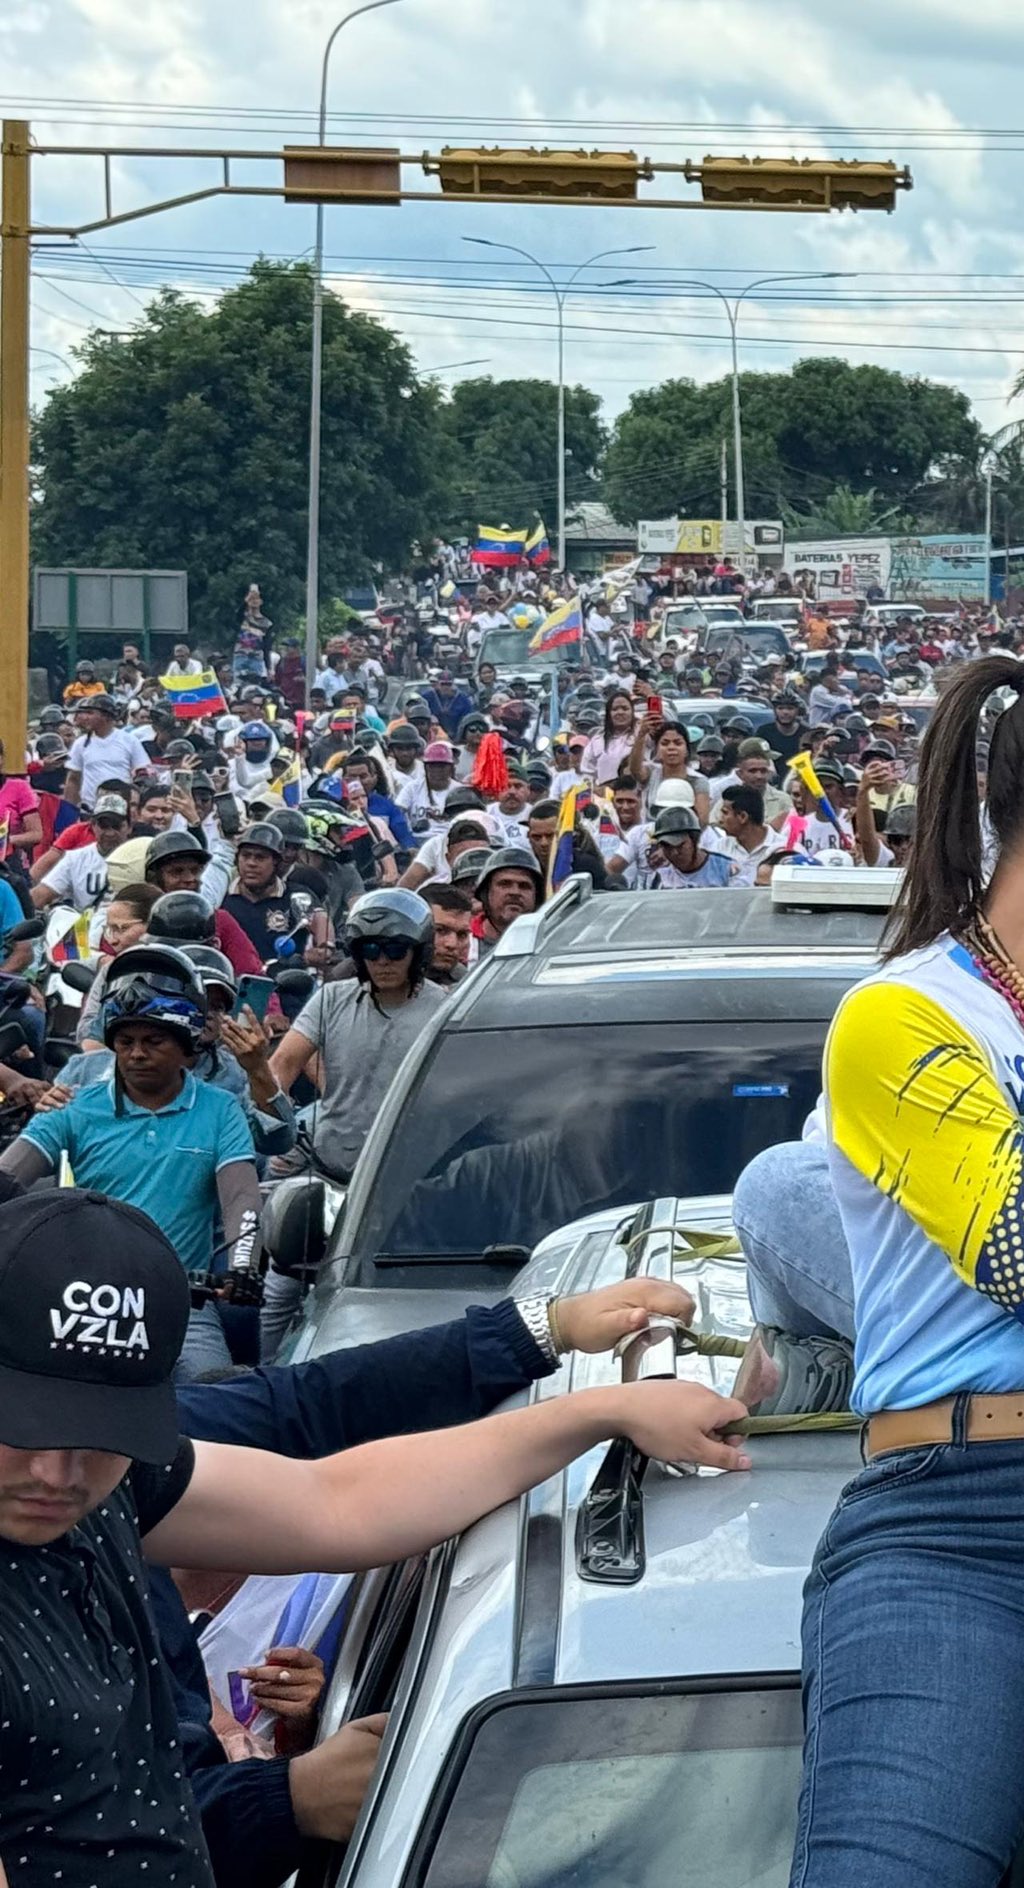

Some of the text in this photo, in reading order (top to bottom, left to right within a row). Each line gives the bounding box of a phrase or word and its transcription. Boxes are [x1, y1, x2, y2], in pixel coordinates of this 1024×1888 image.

[794, 553, 843, 563] BATERIAS
[232, 1221, 257, 1268] SUZUKI
[62, 1280, 146, 1319] CON
[49, 1308, 151, 1350] VZLA
